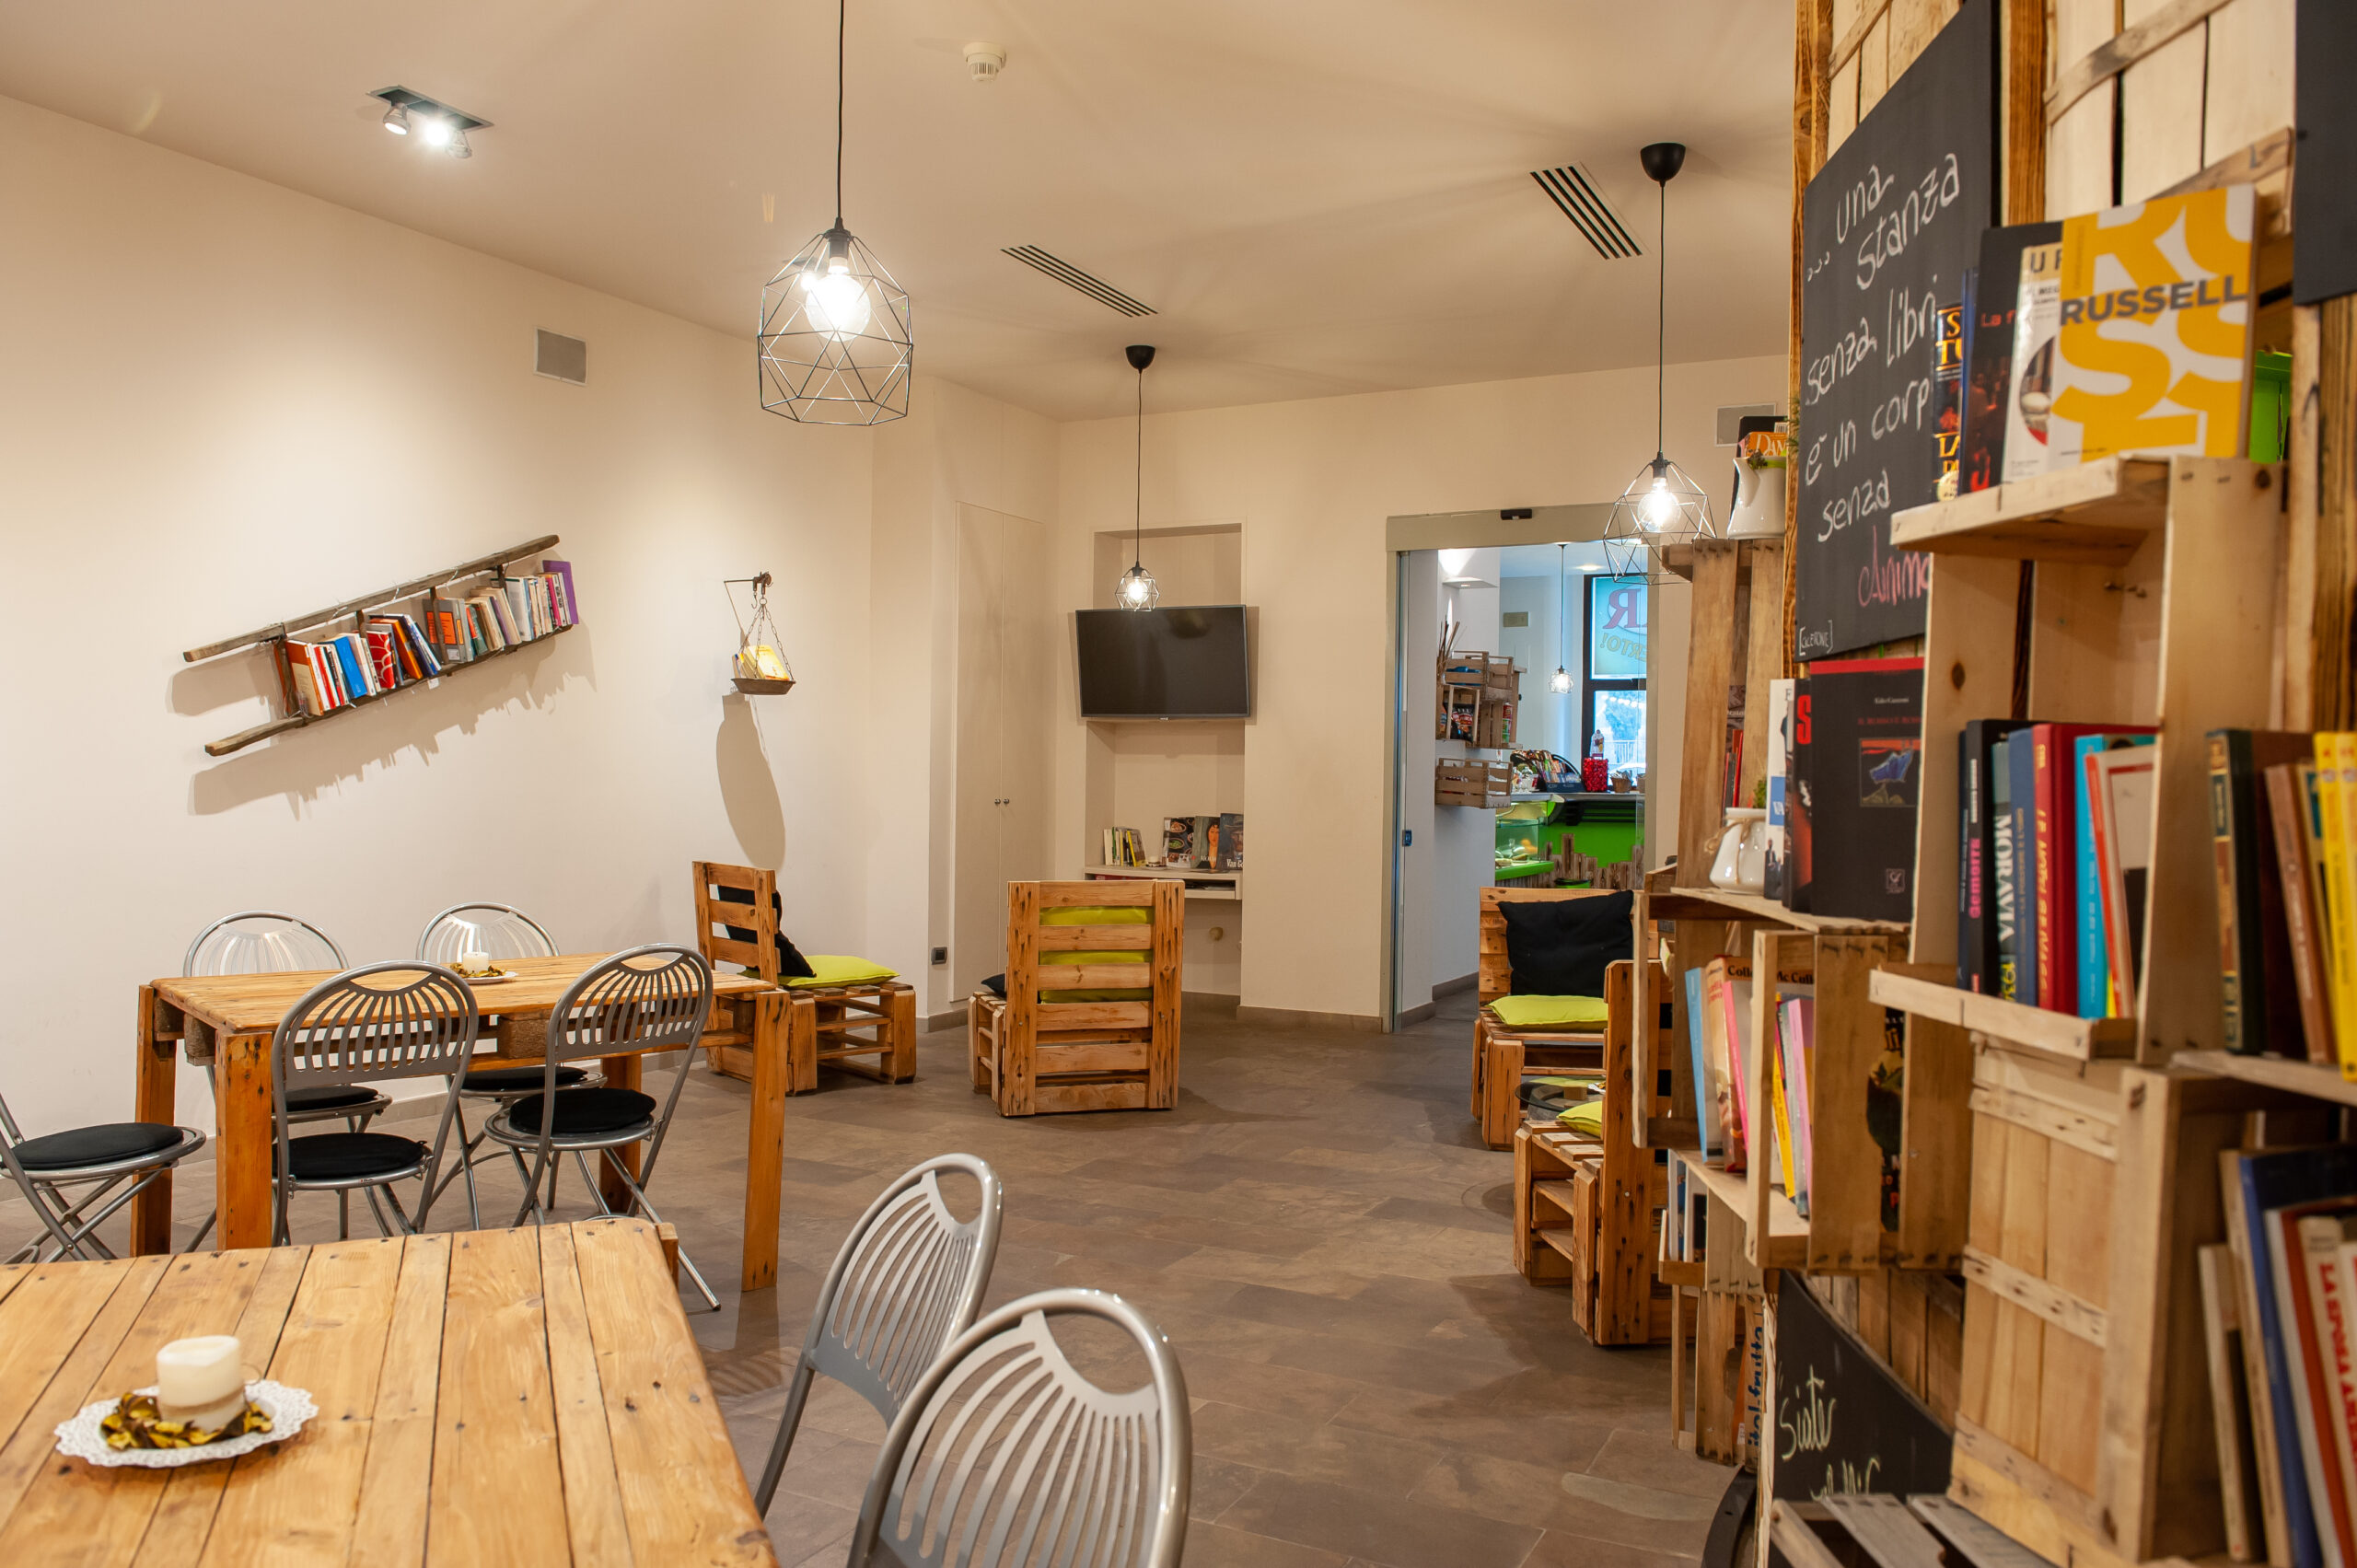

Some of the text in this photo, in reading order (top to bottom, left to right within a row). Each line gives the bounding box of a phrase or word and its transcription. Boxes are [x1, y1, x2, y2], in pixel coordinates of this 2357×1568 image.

[1837, 164, 1895, 245] una
[2060, 274, 2248, 327] RUSSELL
[1805, 316, 1878, 406] senza
[1832, 419, 1857, 468] un
[1871, 377, 1931, 441] corp
[1817, 470, 1891, 543] senza
[1993, 814, 2015, 942] MORAVIA
